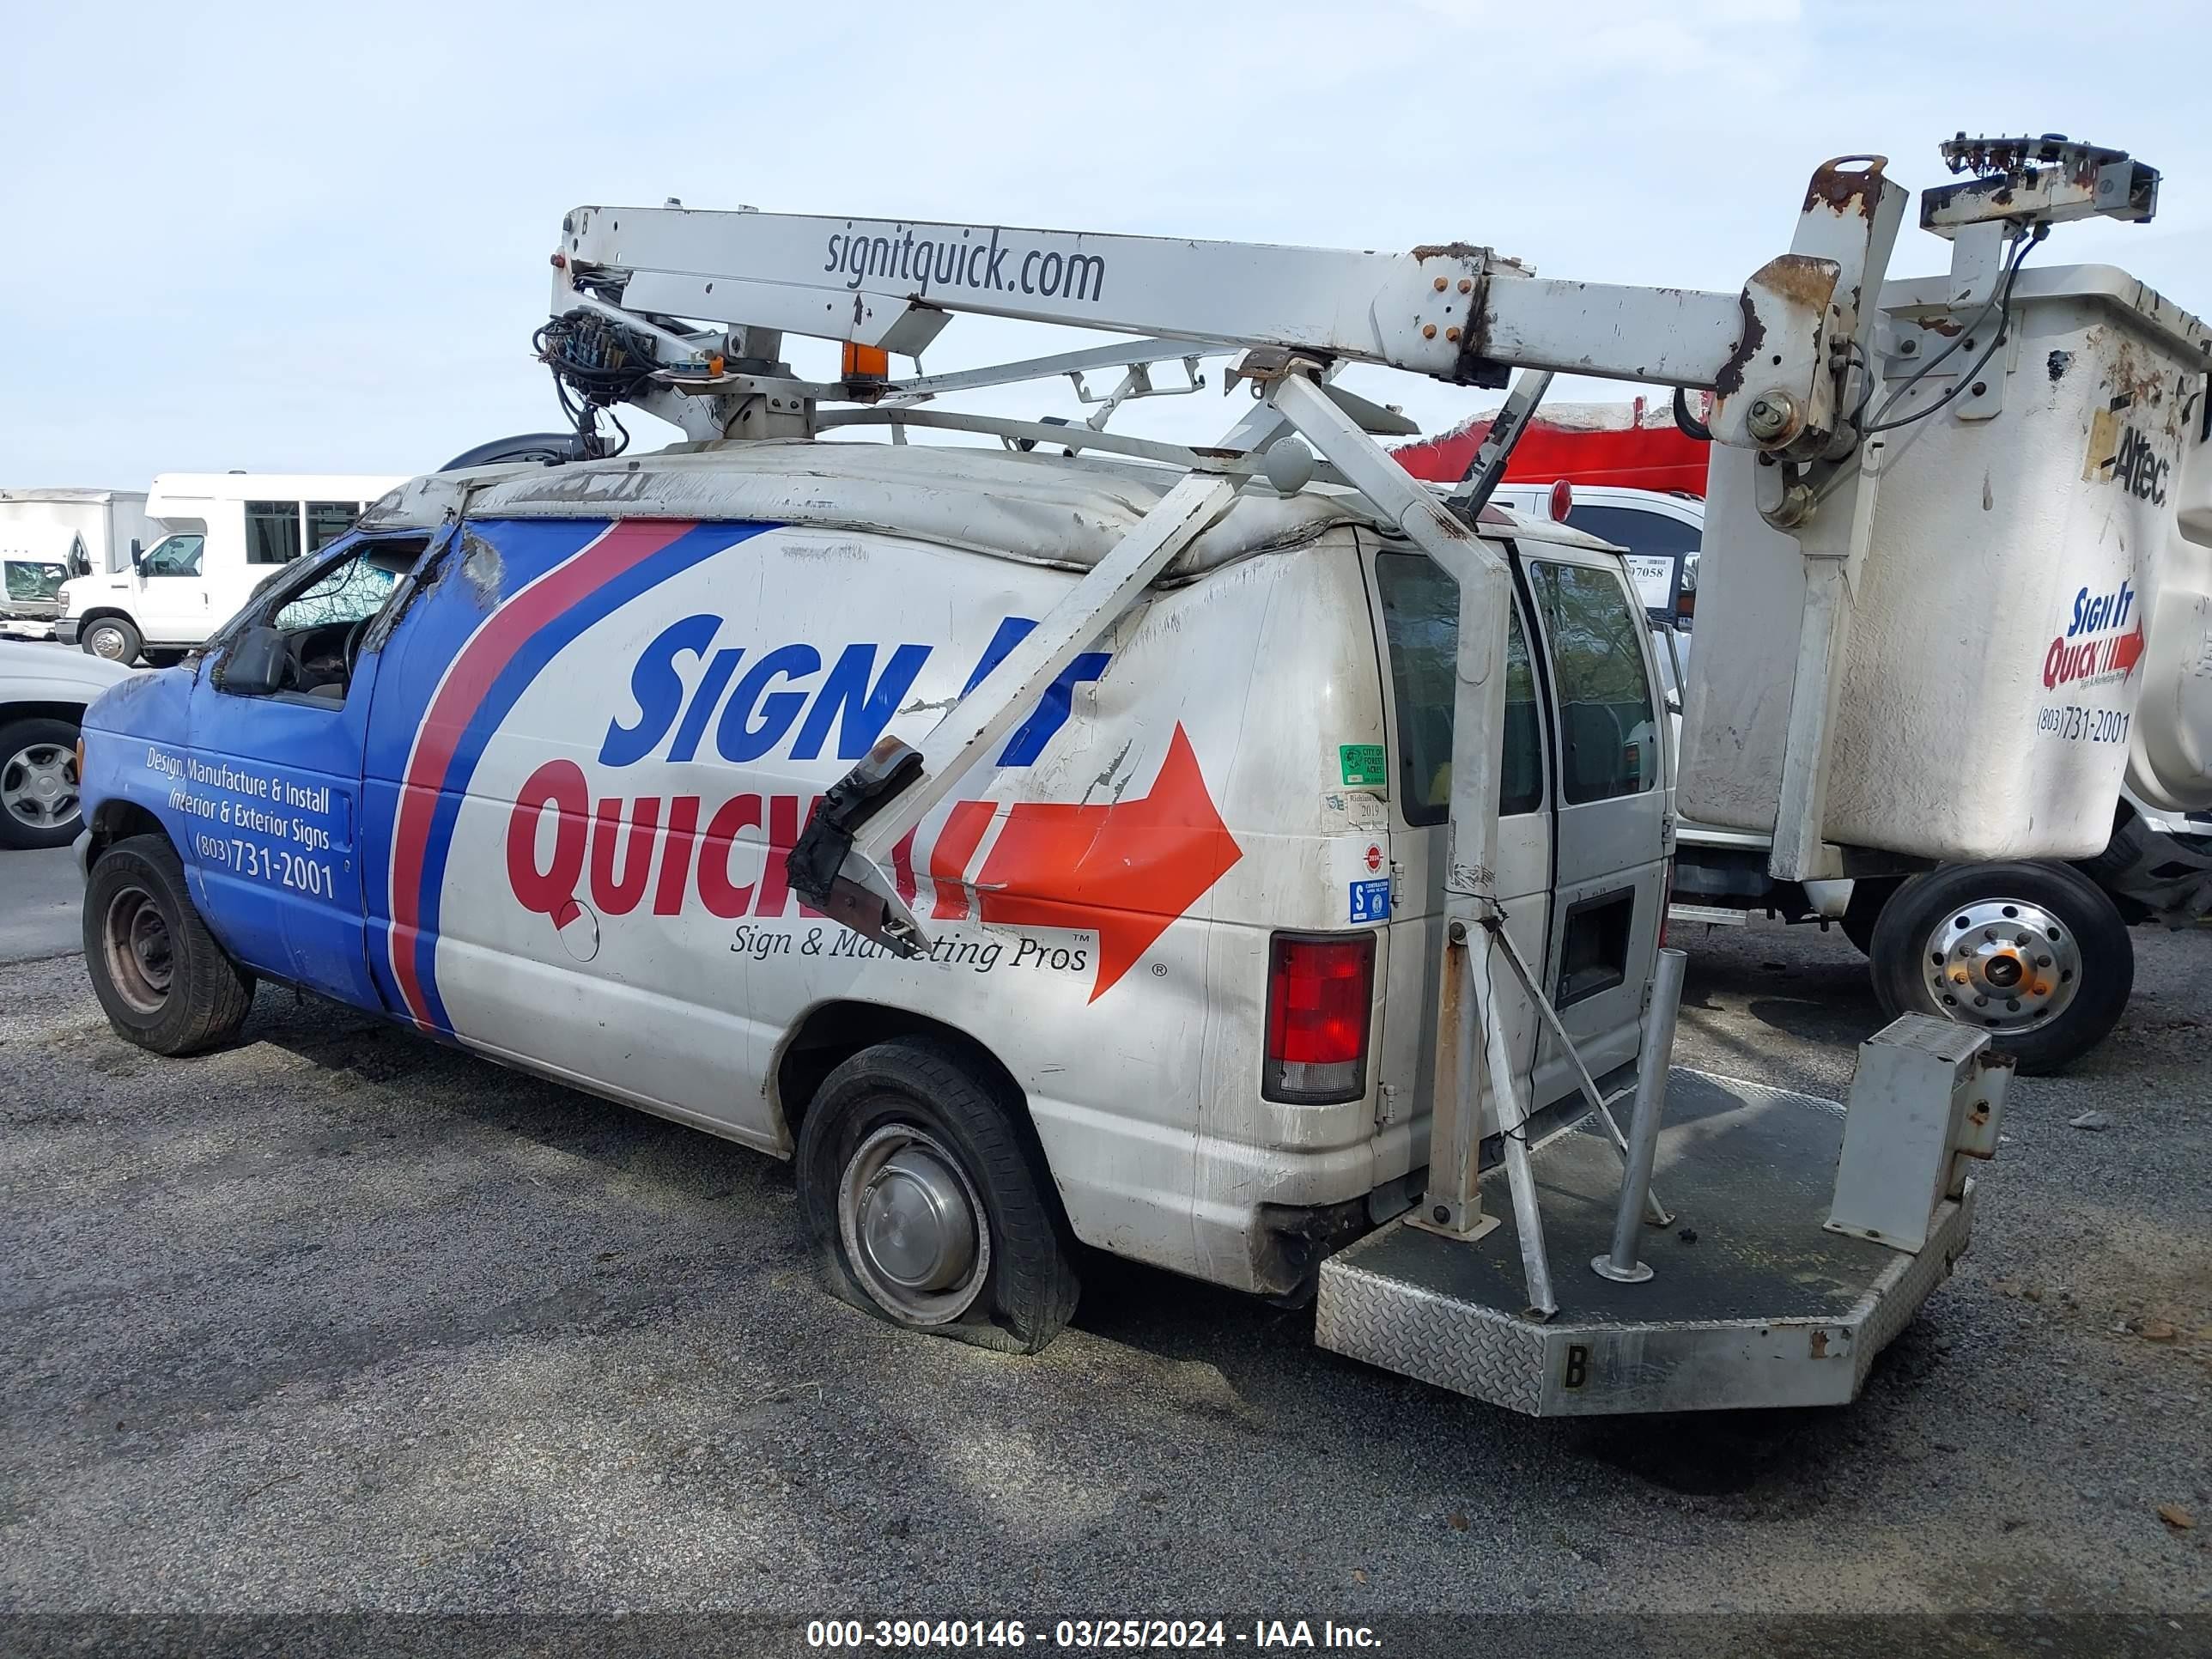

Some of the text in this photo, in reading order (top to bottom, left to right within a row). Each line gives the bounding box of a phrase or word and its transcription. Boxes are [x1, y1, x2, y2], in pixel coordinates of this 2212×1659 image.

[824, 221, 1106, 302] signitquick.com
[2111, 425, 2170, 506] Altec
[599, 613, 933, 768] SIGN
[2043, 635, 2102, 694] QUICK
[2037, 706, 2130, 744] (803)731-2001
[1363, 748, 1375, 757] CITY
[146, 746, 329, 815] Design, Manufacture & Install
[168, 787, 330, 853] Interior & Exterior Signs
[1361, 805, 1379, 817] 2019
[1356, 884, 1364, 911] S
[731, 926, 793, 961] Sign
[799, 927, 823, 956] &
[1008, 937, 1087, 971] Pros
[1565, 1345, 1589, 1389] B
